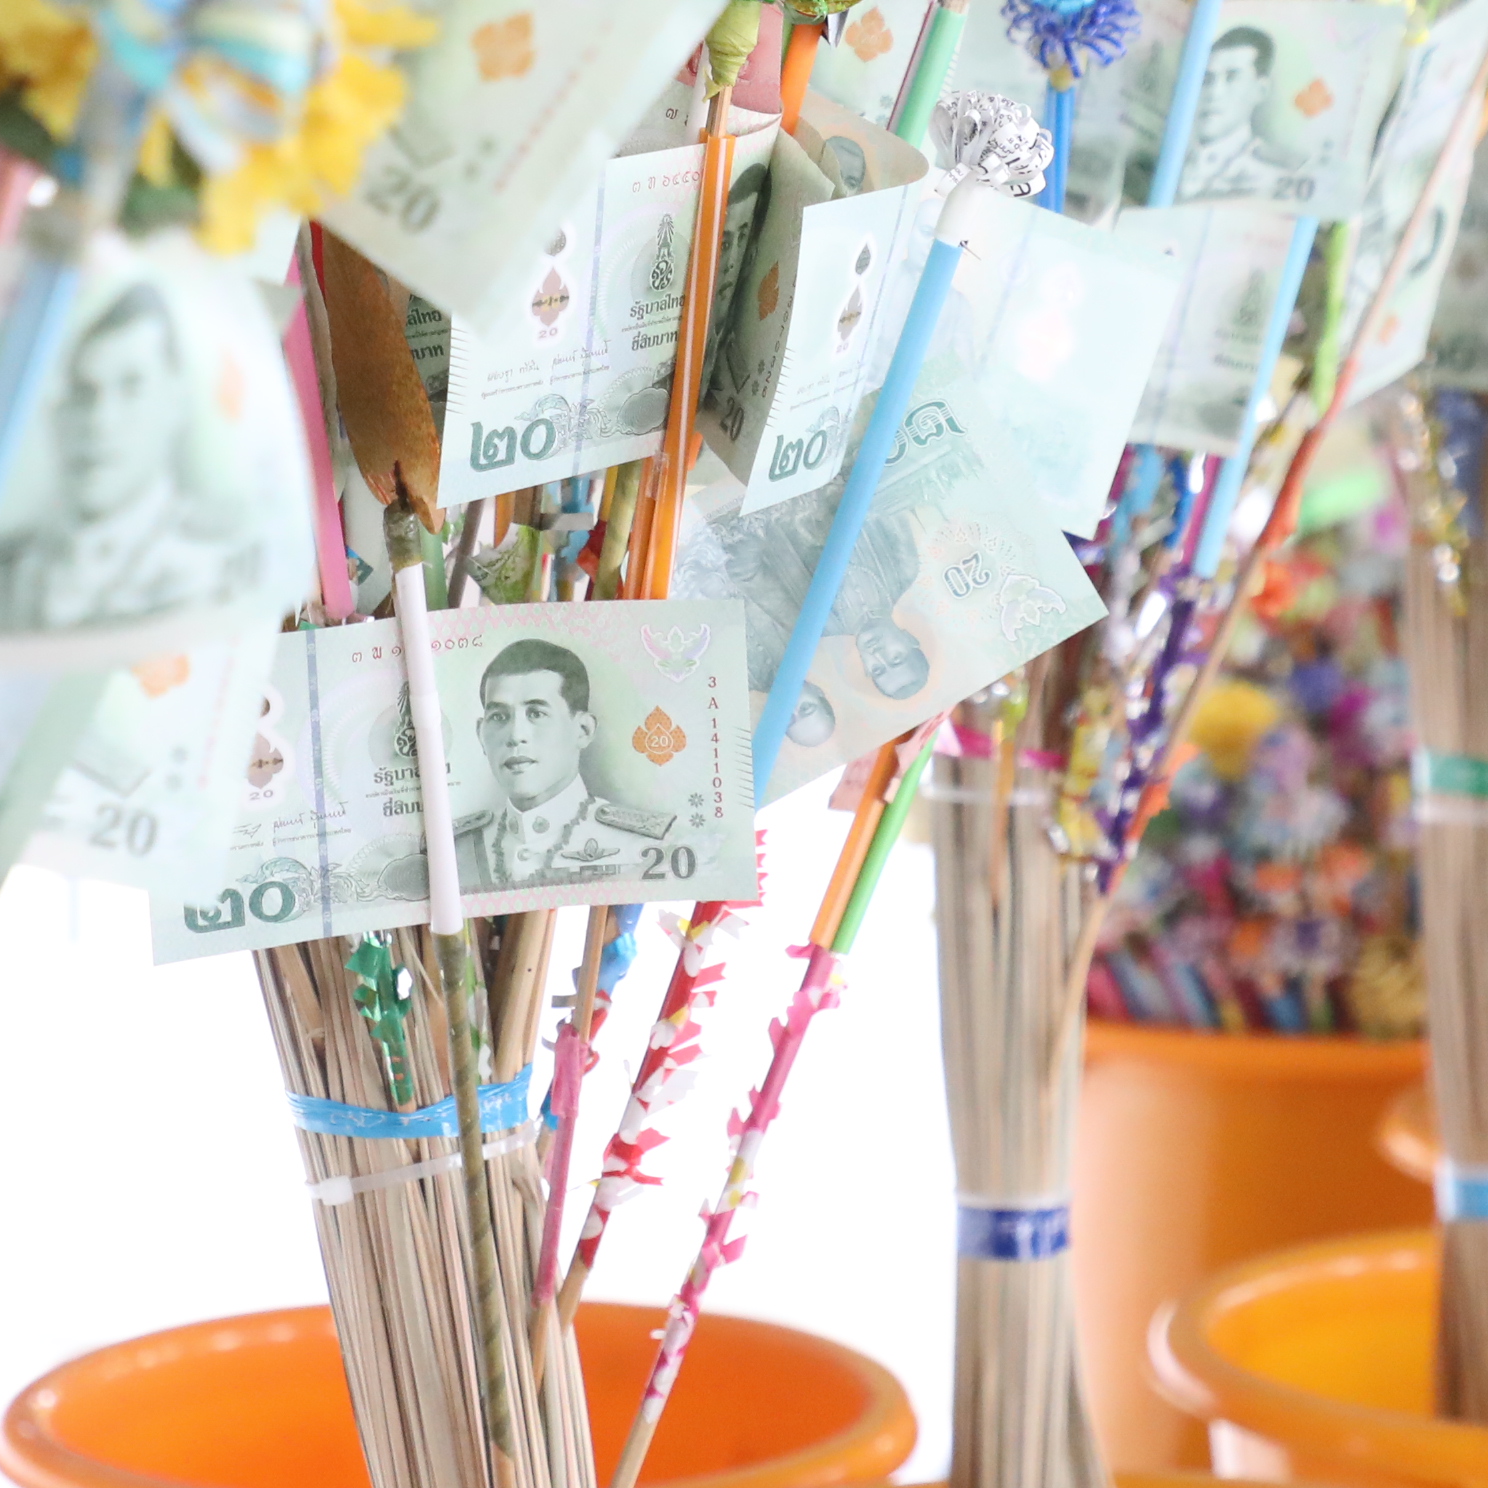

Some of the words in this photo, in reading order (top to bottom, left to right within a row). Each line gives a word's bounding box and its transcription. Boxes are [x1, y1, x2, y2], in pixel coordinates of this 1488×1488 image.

[538, 327, 558, 339] 20
[719, 396, 745, 442] 20
[468, 417, 557, 473] ๒๐
[768, 429, 828, 483] ๒๐
[944, 551, 991, 599] 20
[651, 735, 669, 748] 20
[711, 717, 724, 819] 1411038
[249, 789, 274, 801] 20
[89, 801, 159, 857] 20
[640, 845, 697, 880] 20
[183, 880, 297, 934] ๒๐
